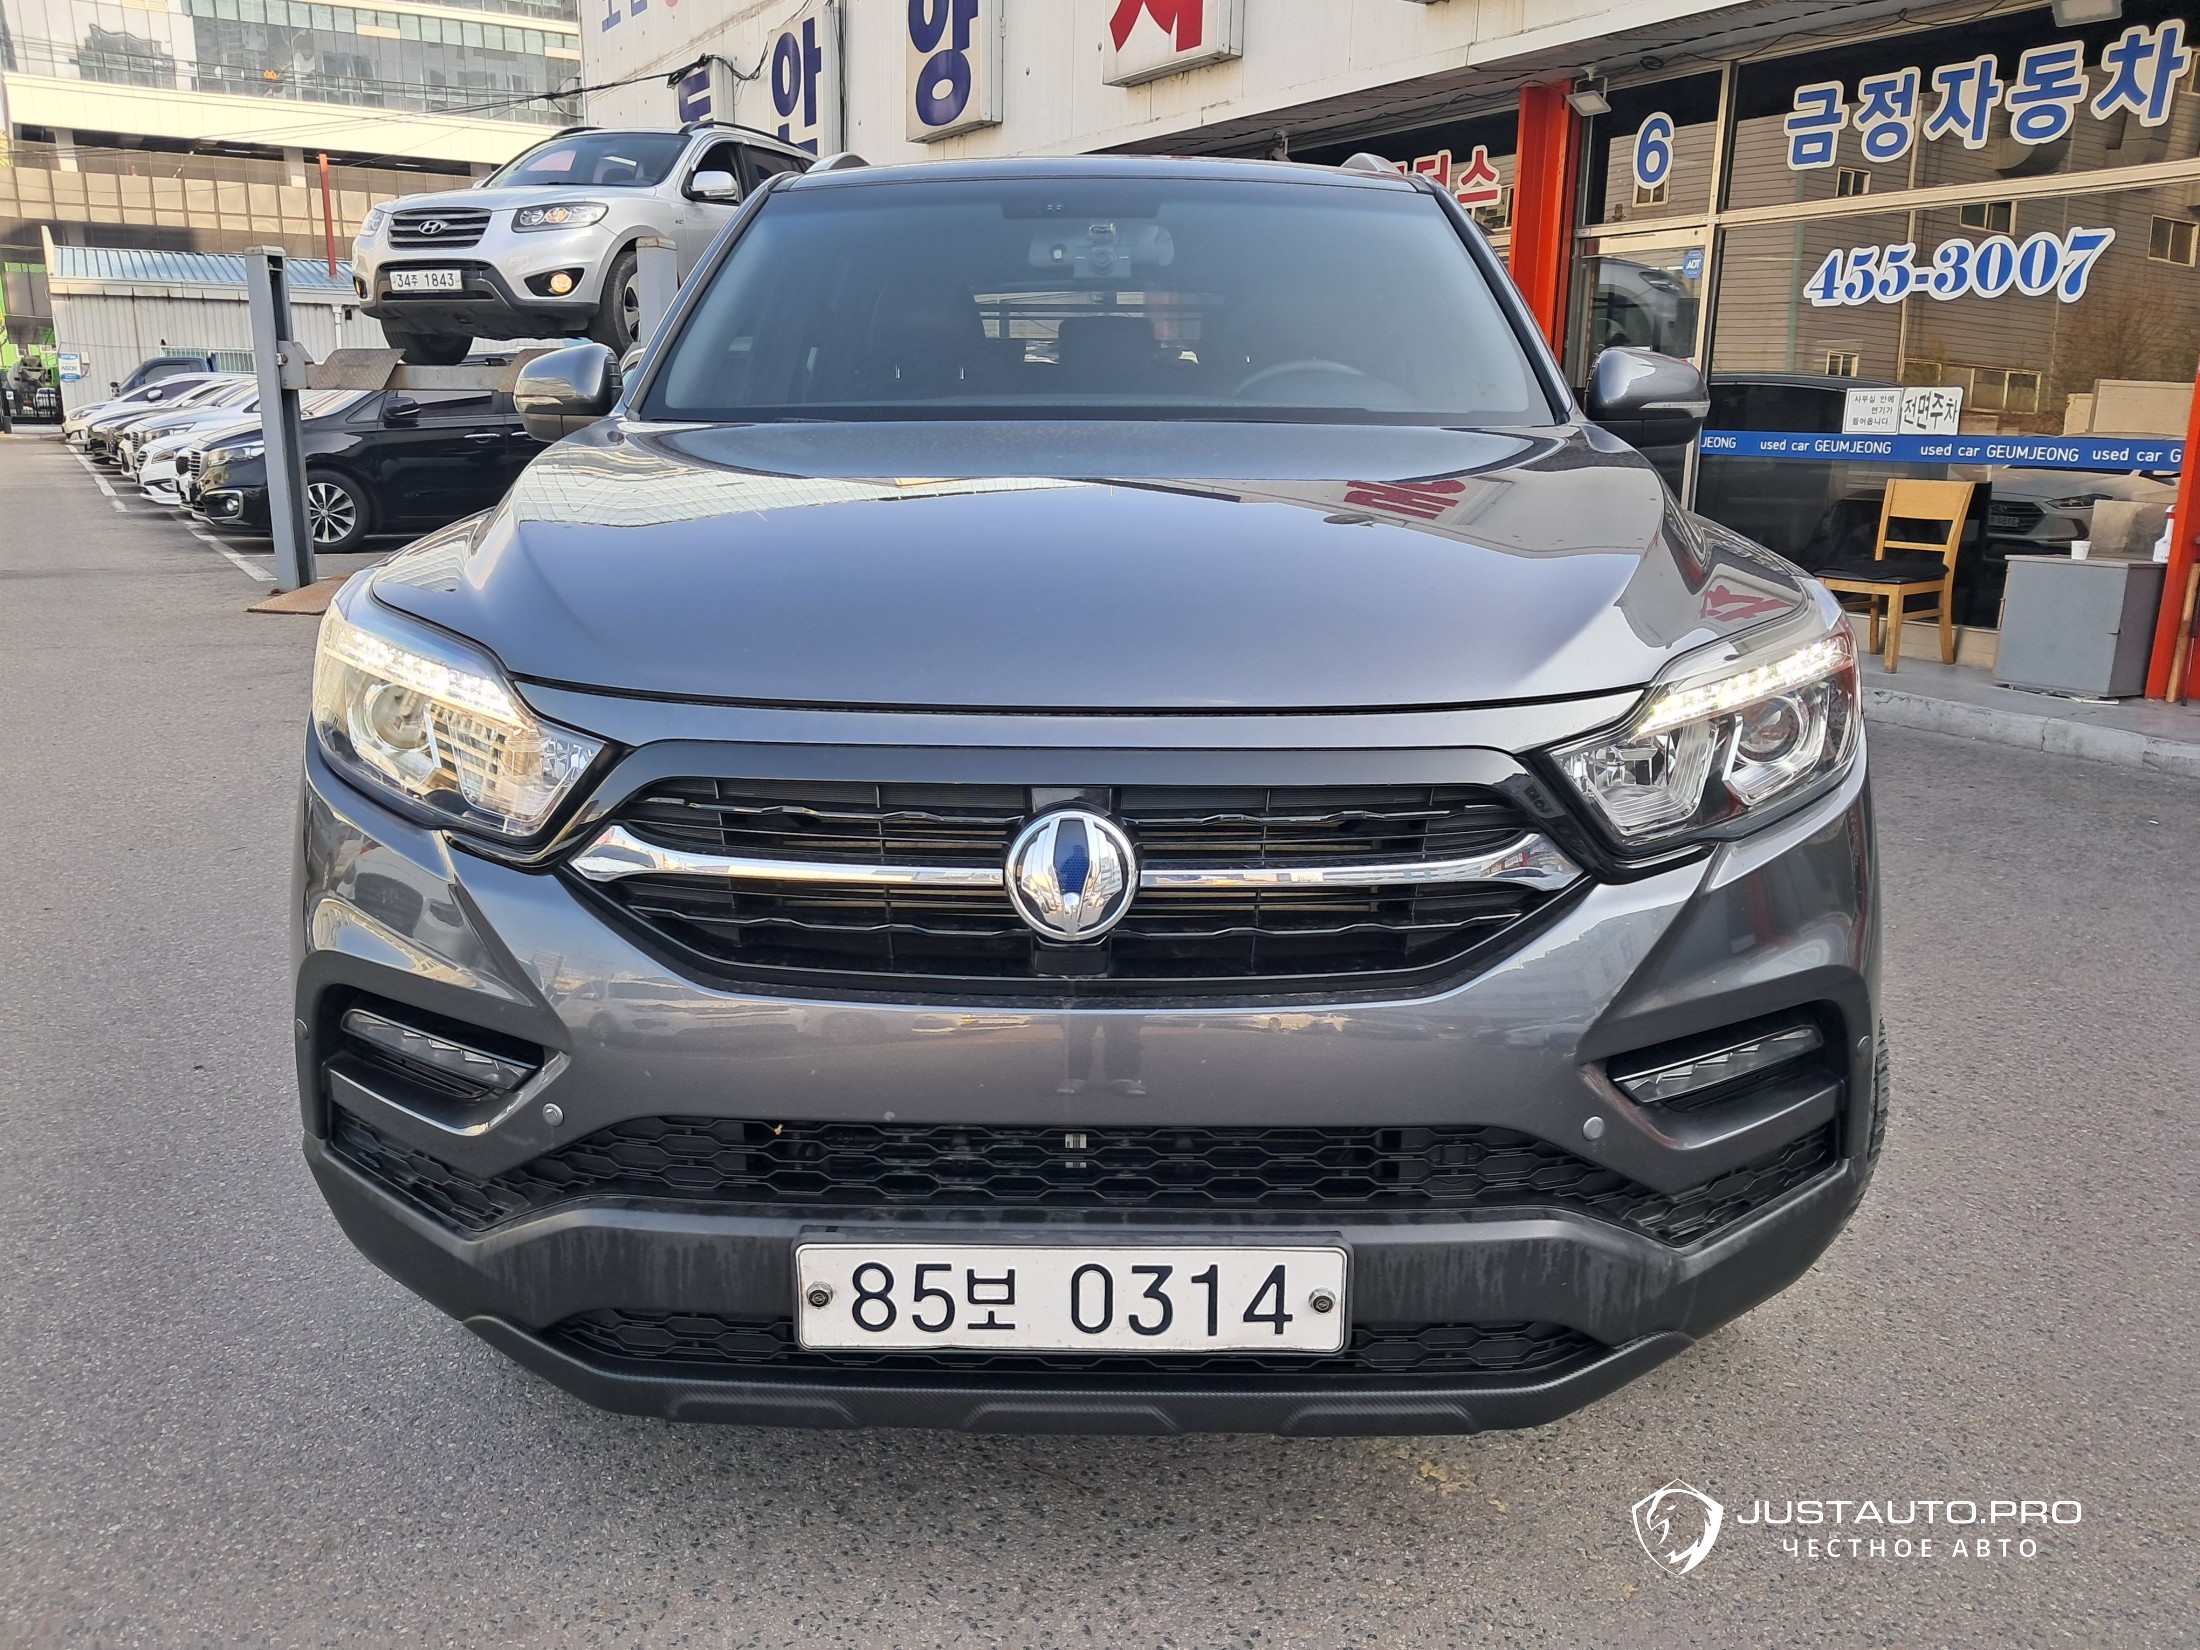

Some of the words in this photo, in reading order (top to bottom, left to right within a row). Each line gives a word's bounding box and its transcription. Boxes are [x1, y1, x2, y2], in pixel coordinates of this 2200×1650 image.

[1785, 22, 2190, 168] 금정자동차
[1634, 114, 1673, 187] 6
[1686, 258, 1701, 270] ADT
[1805, 230, 2114, 304] 455-3007
[396, 273, 418, 288] 34주
[424, 273, 454, 287] 1843
[1853, 394, 1876, 404] 사무실
[1879, 394, 1895, 404] 안에
[1871, 406, 1893, 415] 연기가
[1903, 390, 1958, 431] 전면주차
[1760, 439, 1786, 451] used
[1791, 442, 1810, 452] car
[1814, 439, 1892, 455] GEUMJEONG
[1920, 443, 1952, 457] used
[1958, 446, 1980, 457] car
[1986, 444, 2080, 463] GEUMJEONG
[2092, 447, 2129, 462] used
[2136, 450, 2163, 463] car
[850, 1261, 1016, 1333] 85보
[1070, 1263, 1294, 1337] 0314
